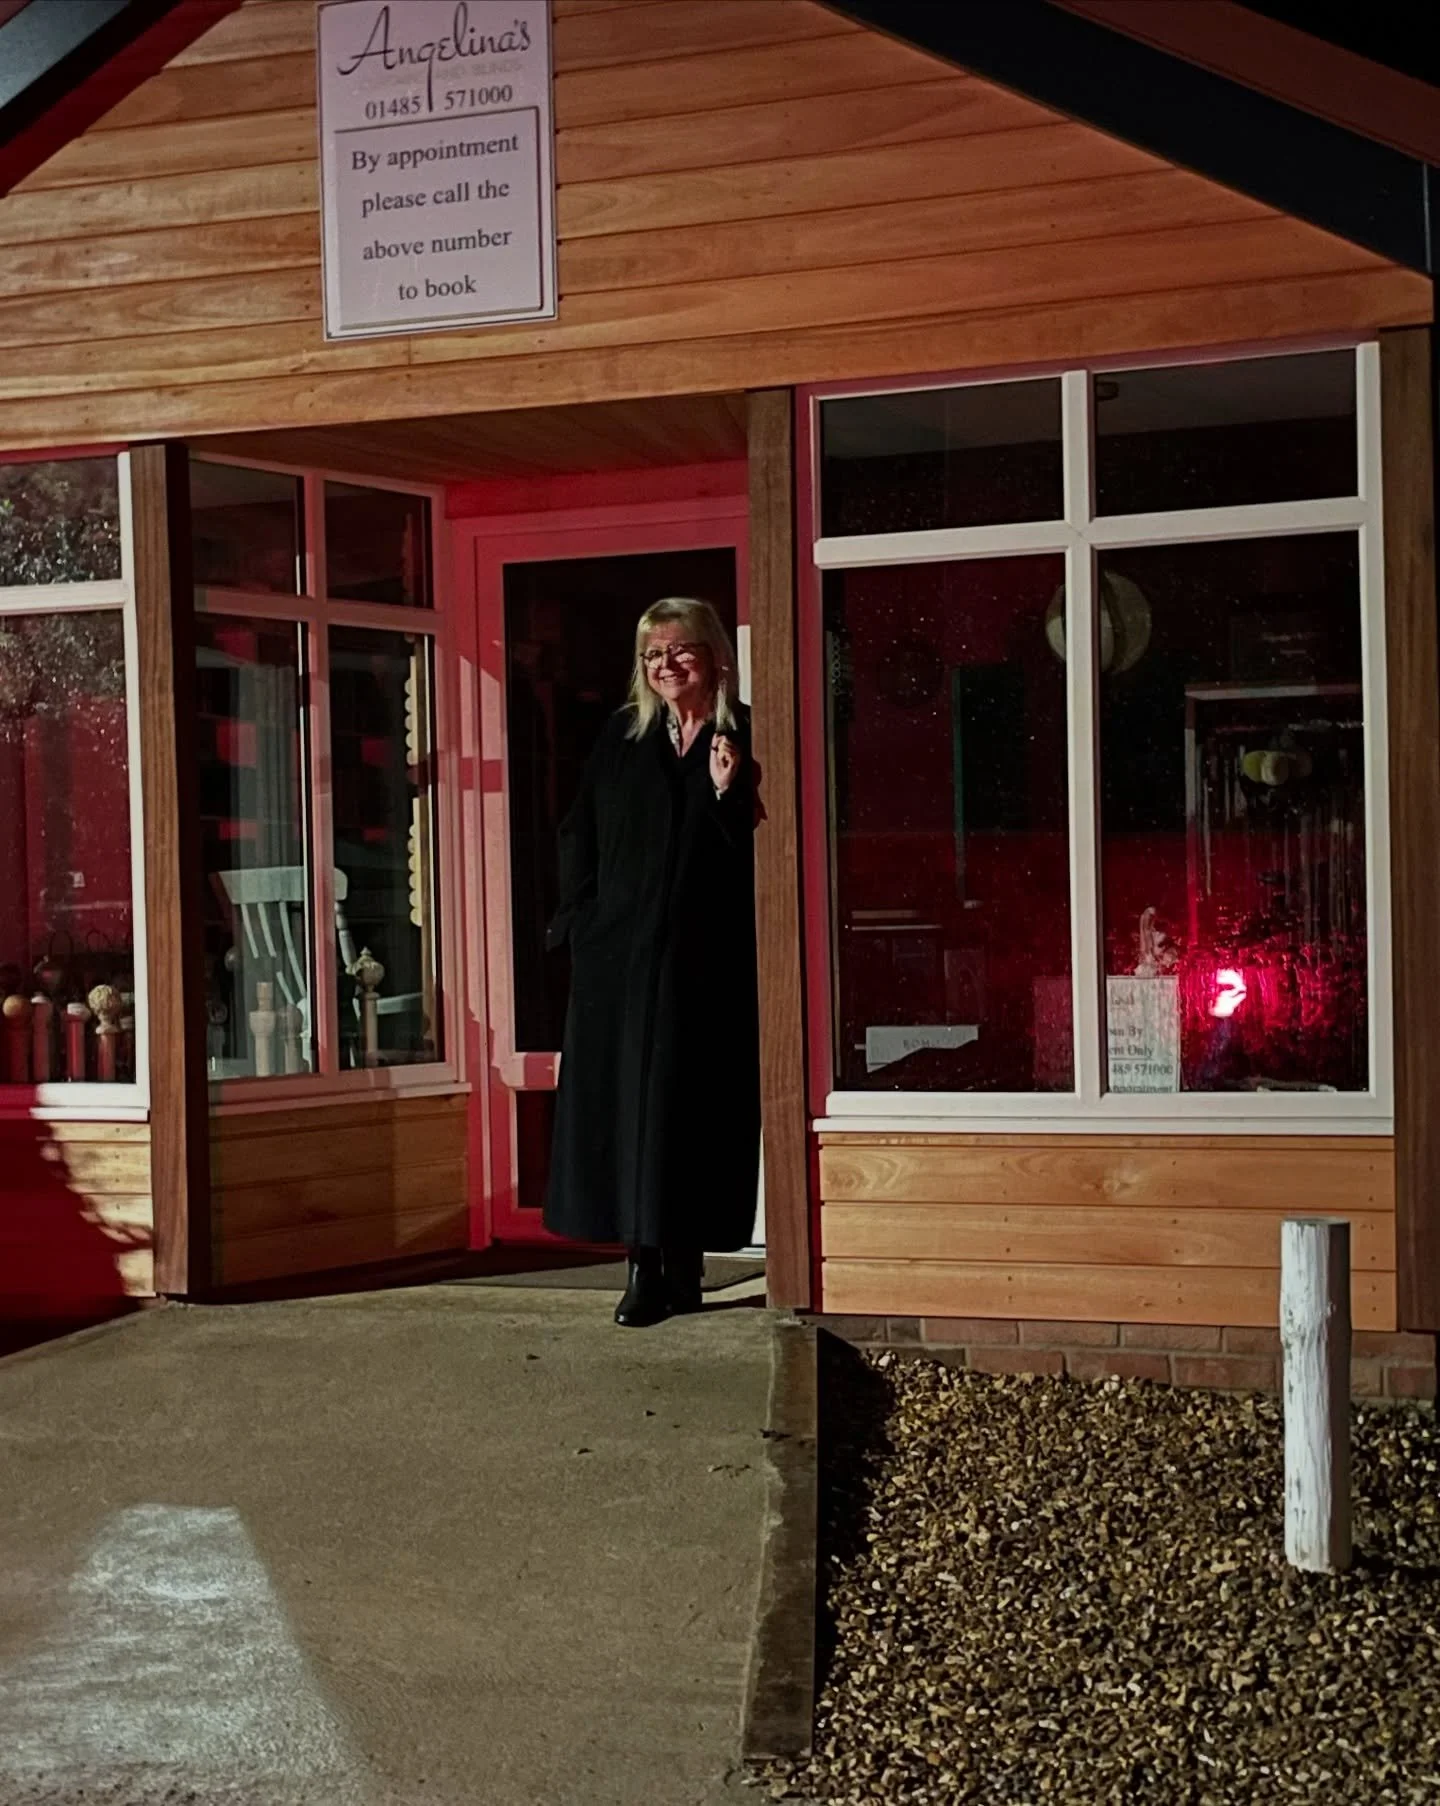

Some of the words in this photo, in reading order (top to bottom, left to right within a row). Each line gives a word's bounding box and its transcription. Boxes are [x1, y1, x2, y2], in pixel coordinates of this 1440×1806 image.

[336, 2, 531, 112] Angelina's
[365, 95, 421, 120] 01485
[444, 85, 513, 110] 571000
[351, 150, 380, 173] By
[387, 133, 519, 170] appointment
[361, 191, 427, 218] please
[432, 181, 469, 204] call
[477, 179, 510, 200] the
[363, 240, 424, 261] above
[431, 228, 512, 254] number
[398, 283, 418, 301] to
[425, 274, 477, 298] book
[1127, 1044, 1155, 1058] Only
